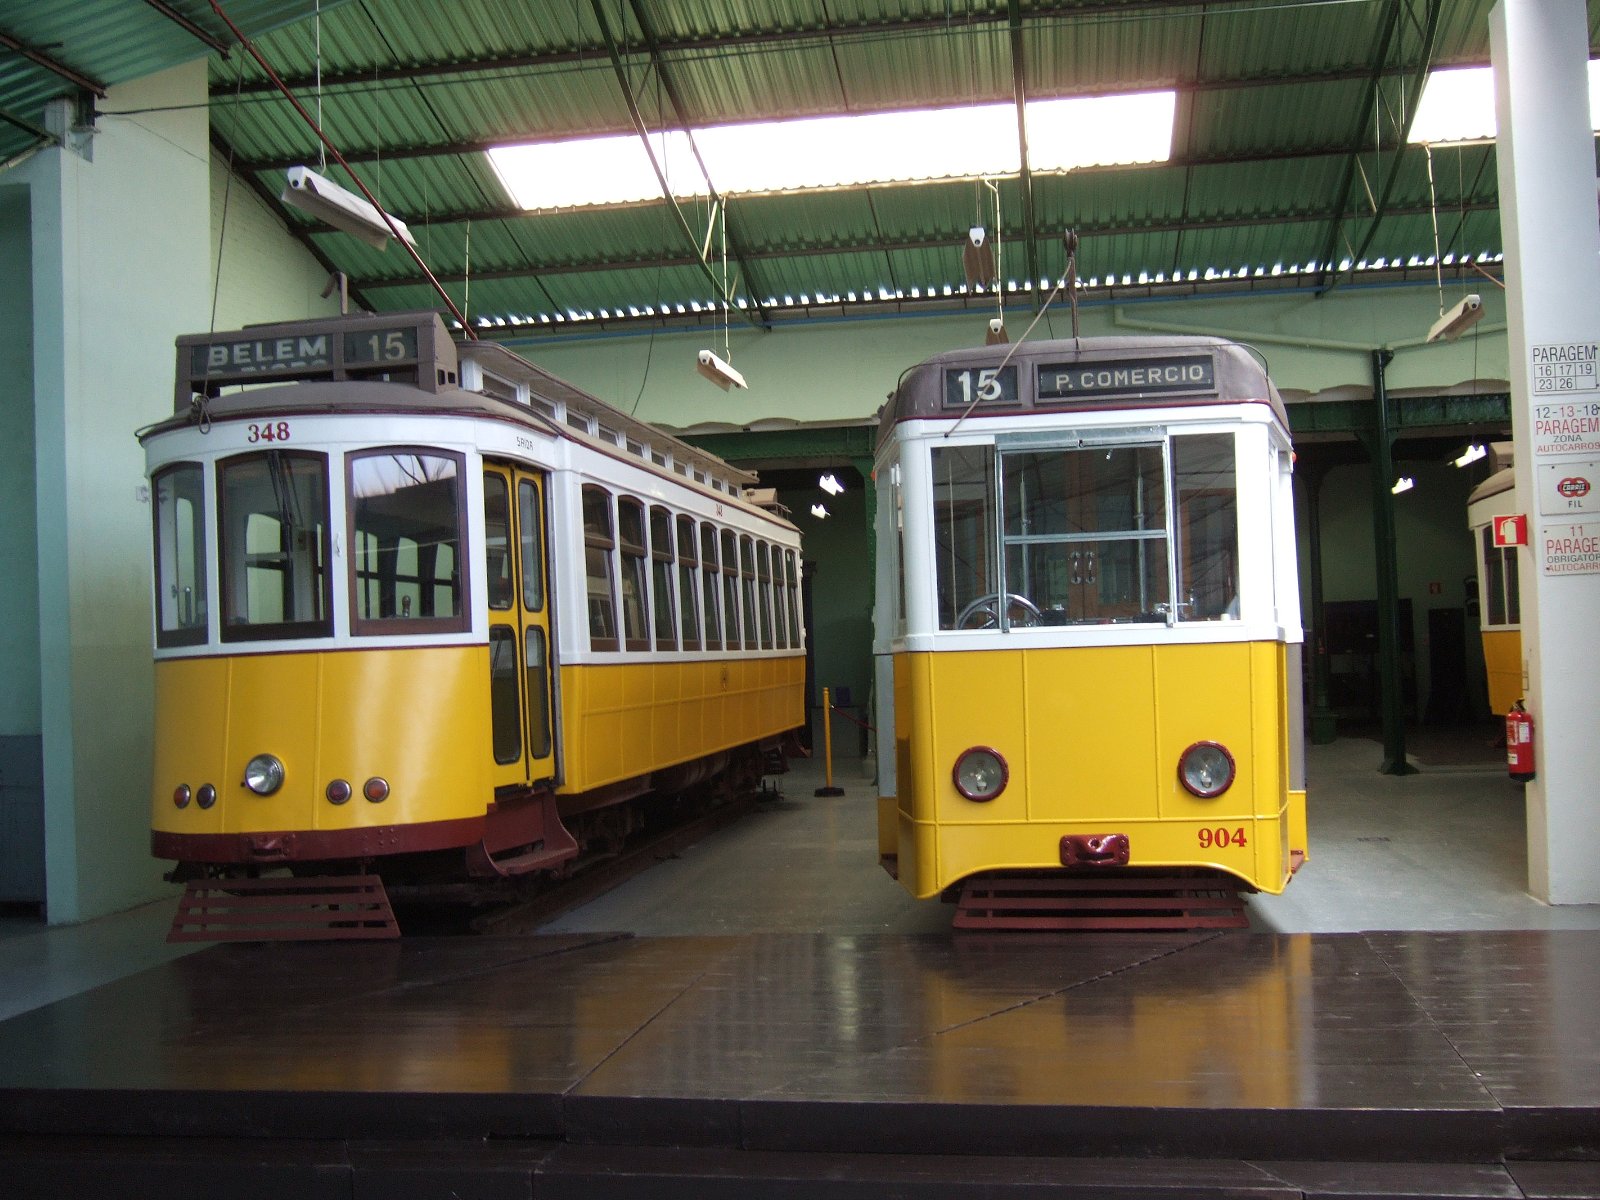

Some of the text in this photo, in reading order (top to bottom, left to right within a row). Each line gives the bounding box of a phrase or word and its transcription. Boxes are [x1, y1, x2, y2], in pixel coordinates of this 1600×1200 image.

[208, 335, 327, 366] BELEM
[368, 332, 406, 361] 15
[1533, 345, 1596, 362] PARAGEM
[1081, 365, 1204, 388] COMERCIO
[1539, 363, 1592, 376] 16 17 19
[958, 369, 1002, 402] 15
[1539, 378, 1573, 390] 23 26
[248, 421, 290, 443] 348
[1536, 418, 1600, 435] PARAGEM
[1537, 442, 1600, 452] AUTOCARROS
[1553, 435, 1582, 443] ZONA
[1568, 500, 1583, 508] FIL
[1570, 525, 1583, 536] 11
[1546, 537, 1600, 554] PARAGE
[1548, 562, 1600, 571] AUTOCARR
[1198, 827, 1248, 849] 904
